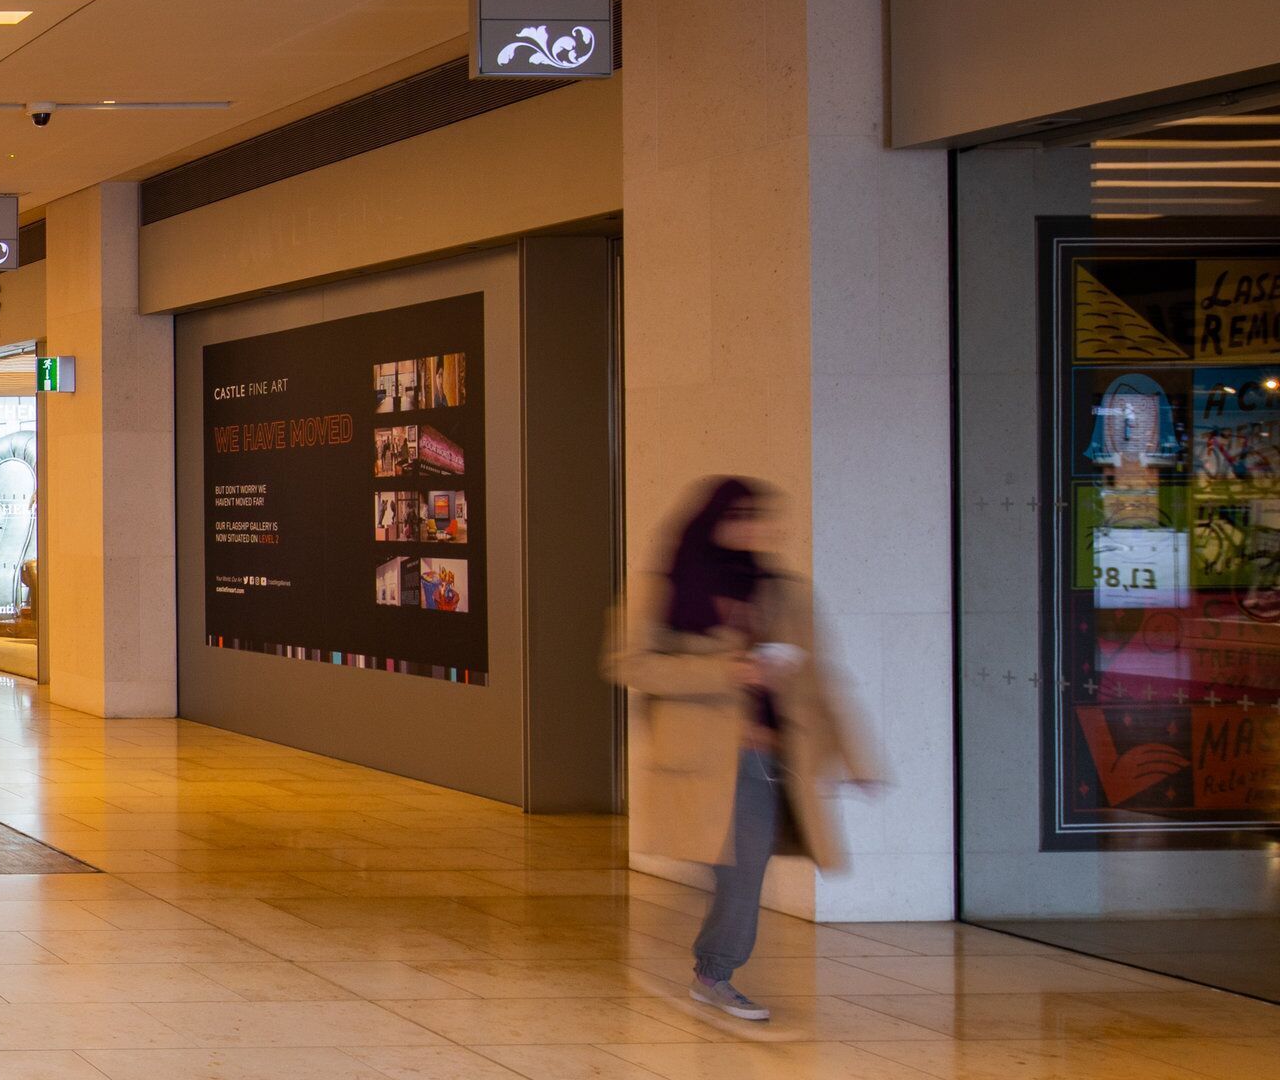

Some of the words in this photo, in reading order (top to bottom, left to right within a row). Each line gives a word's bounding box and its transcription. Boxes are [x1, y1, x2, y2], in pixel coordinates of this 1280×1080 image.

[214, 384, 245, 400] CASTLE
[248, 381, 268, 396] FINE
[271, 378, 288, 393] ART
[214, 425, 239, 453] WE
[243, 421, 286, 451] HAVE
[290, 413, 353, 448] MOVED
[215, 485, 224, 494] BUT
[225, 485, 240, 494] DON'T
[240, 484, 257, 494] WORRY
[258, 484, 267, 494] WE
[215, 497, 235, 507] HAVEN'T
[235, 497, 253, 506] MOVED
[253, 497, 265, 506] FAR!
[215, 522, 225, 530] OUR
[226, 522, 250, 531] FLAGSHIP
[250, 522, 273, 531] GALLERY
[272, 522, 278, 531] IS
[215, 533, 227, 542] NOW
[227, 533, 250, 543] SITUATED
[250, 534, 258, 543] ON
[259, 534, 274, 544] LEVEL
